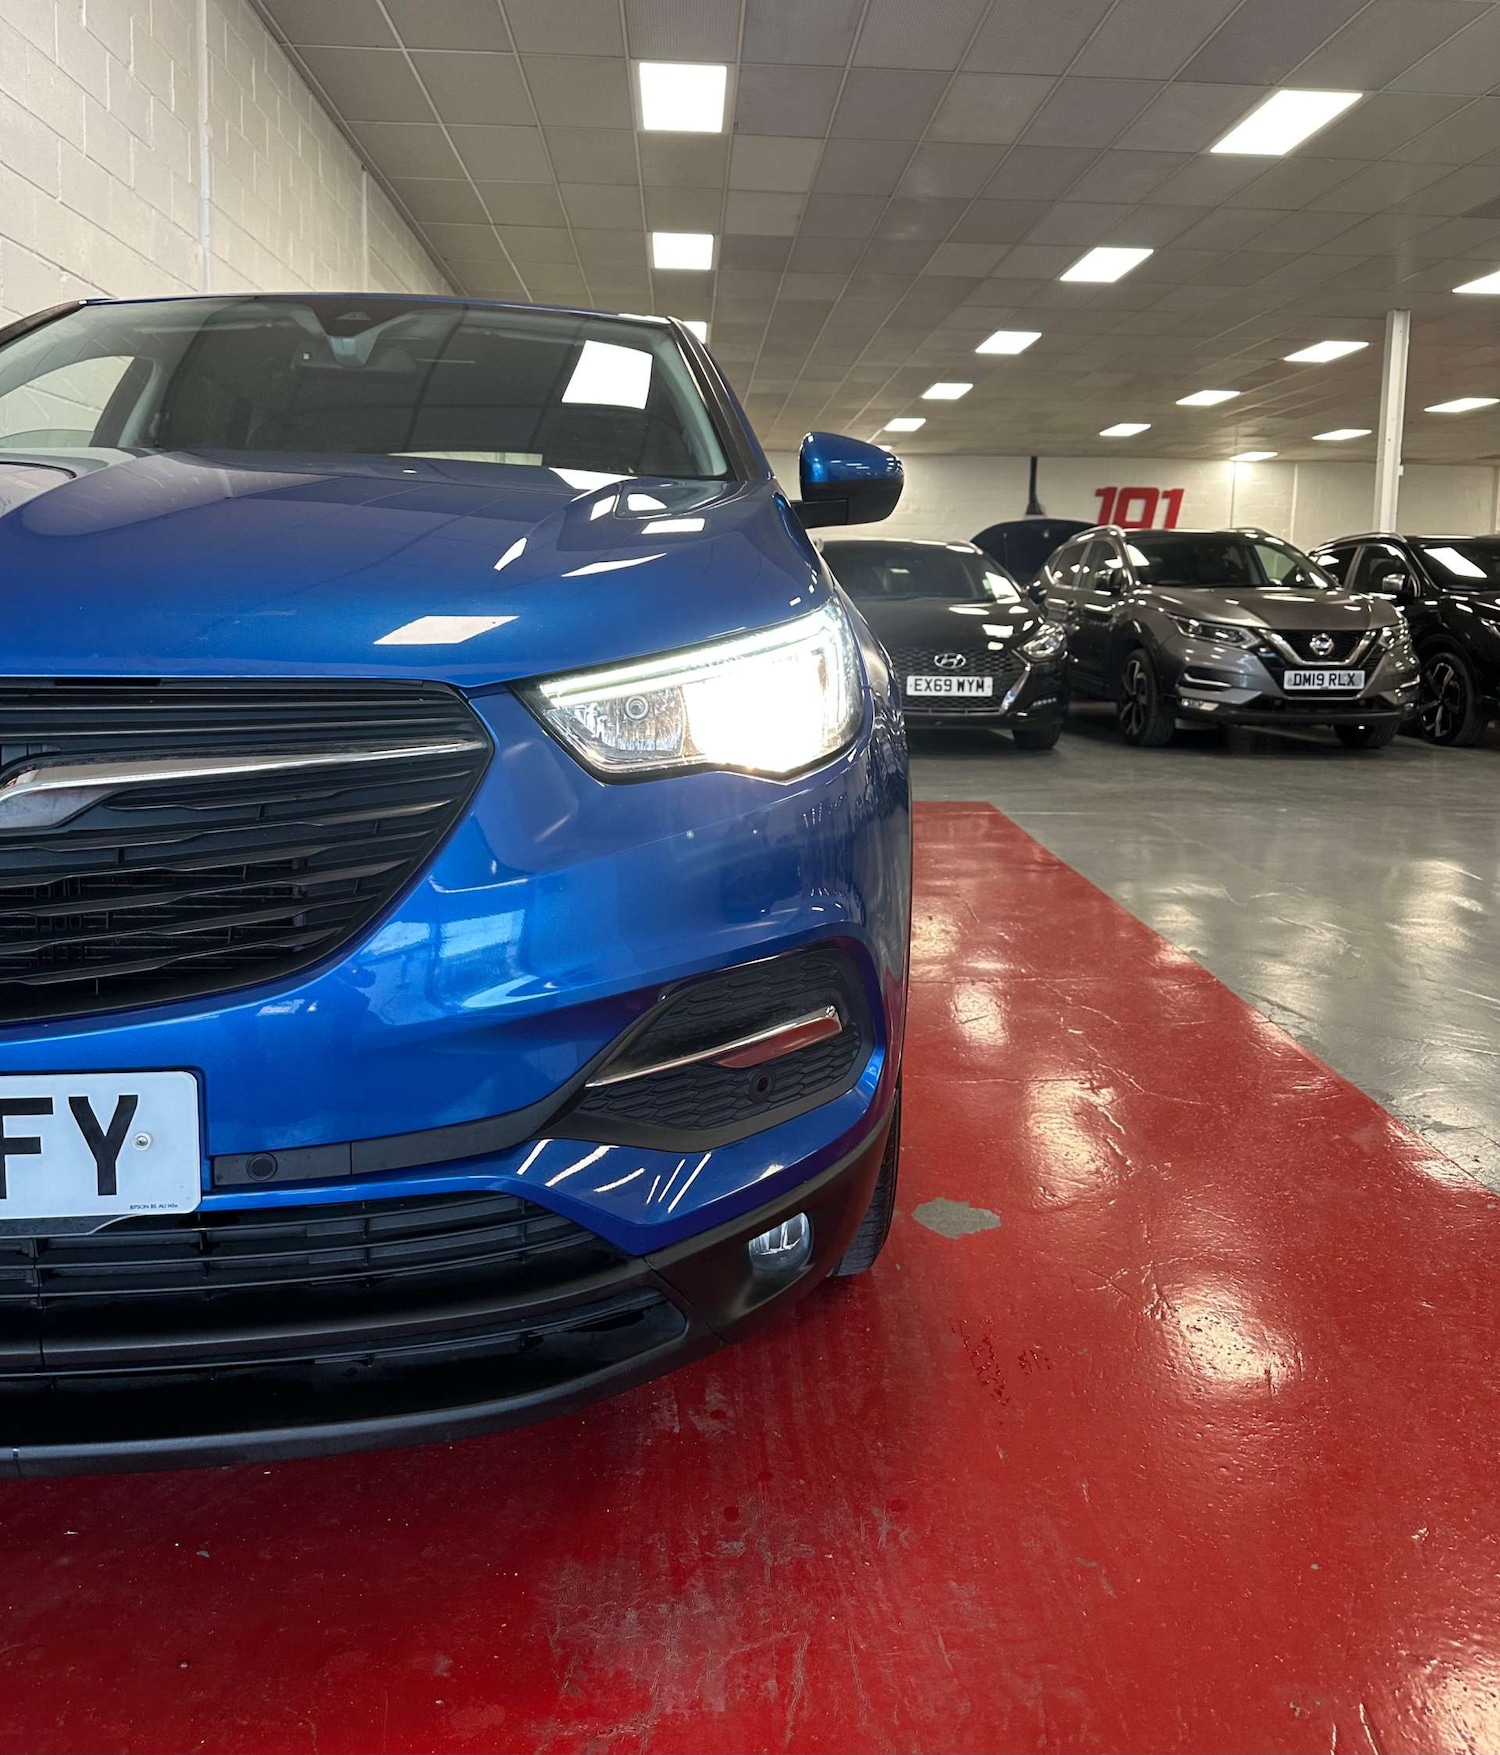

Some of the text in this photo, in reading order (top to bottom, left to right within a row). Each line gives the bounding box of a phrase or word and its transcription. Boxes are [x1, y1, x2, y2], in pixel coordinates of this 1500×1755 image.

[1094, 487, 1185, 530] 101
[914, 678, 985, 693] EX69 WYM
[1293, 673, 1356, 686] DM19 RLX
[0, 1094, 139, 1200] FY
